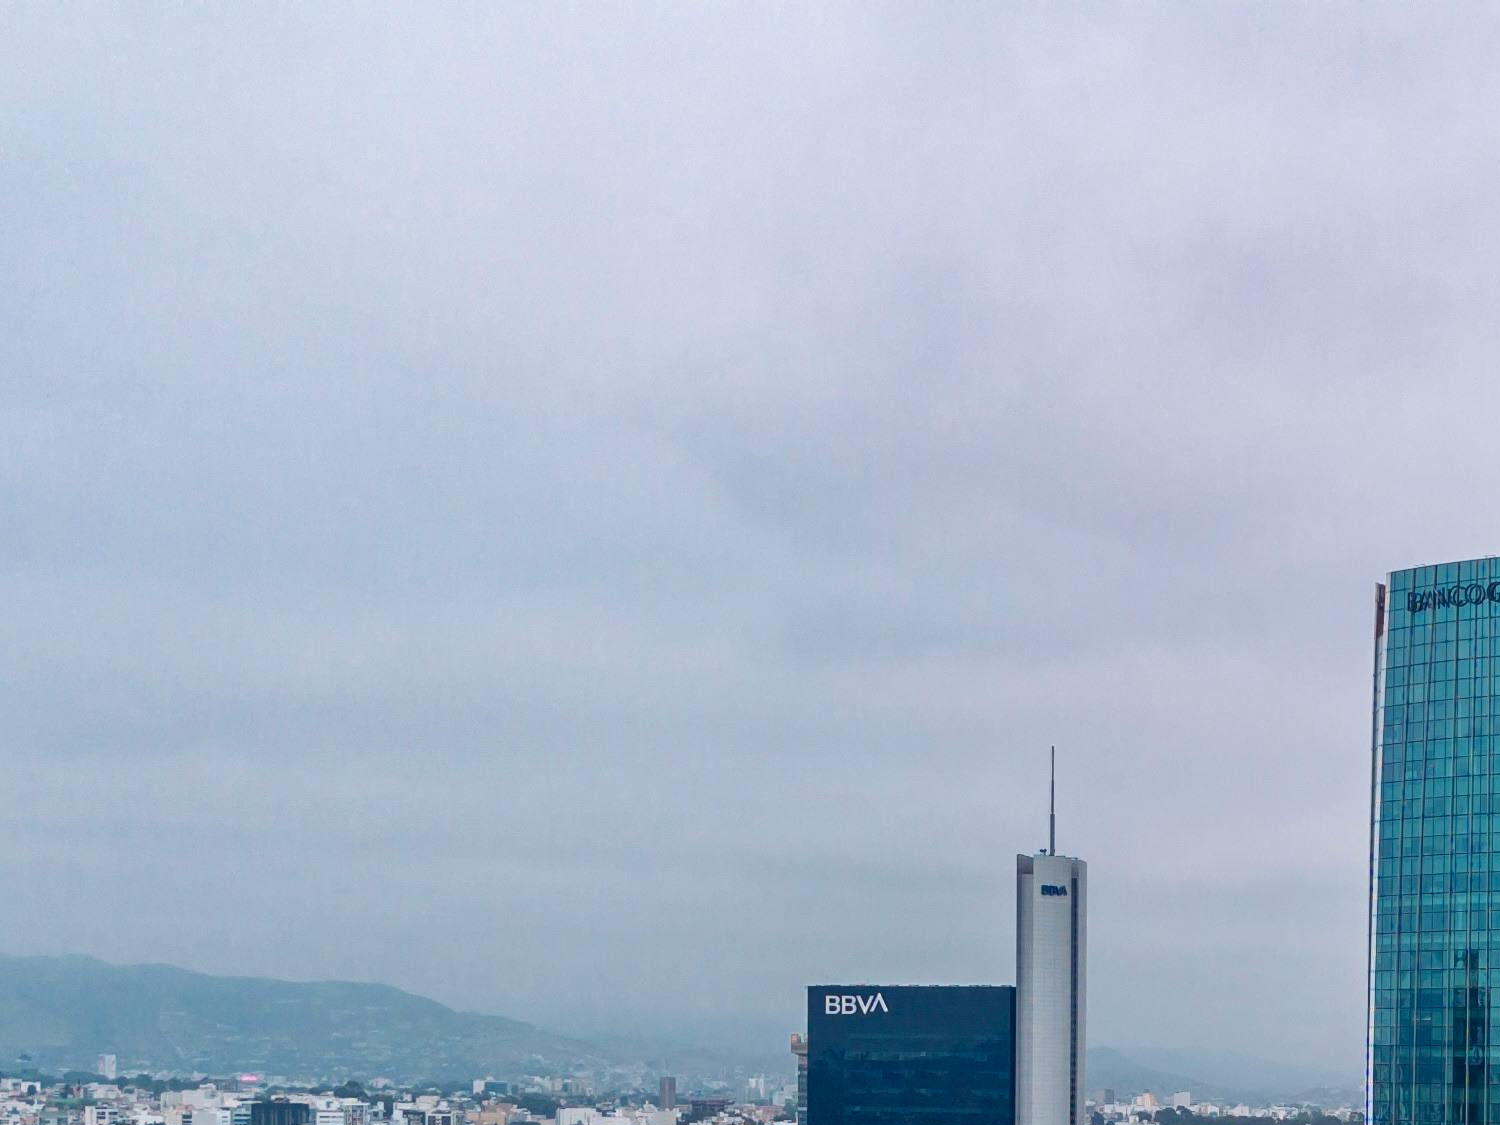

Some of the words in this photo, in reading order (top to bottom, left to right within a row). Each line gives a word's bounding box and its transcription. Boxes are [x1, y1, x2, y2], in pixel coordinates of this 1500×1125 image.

[1407, 583, 1485, 613] BANCO
[1041, 884, 1067, 896] BBVA
[825, 992, 889, 1015] BBVA
